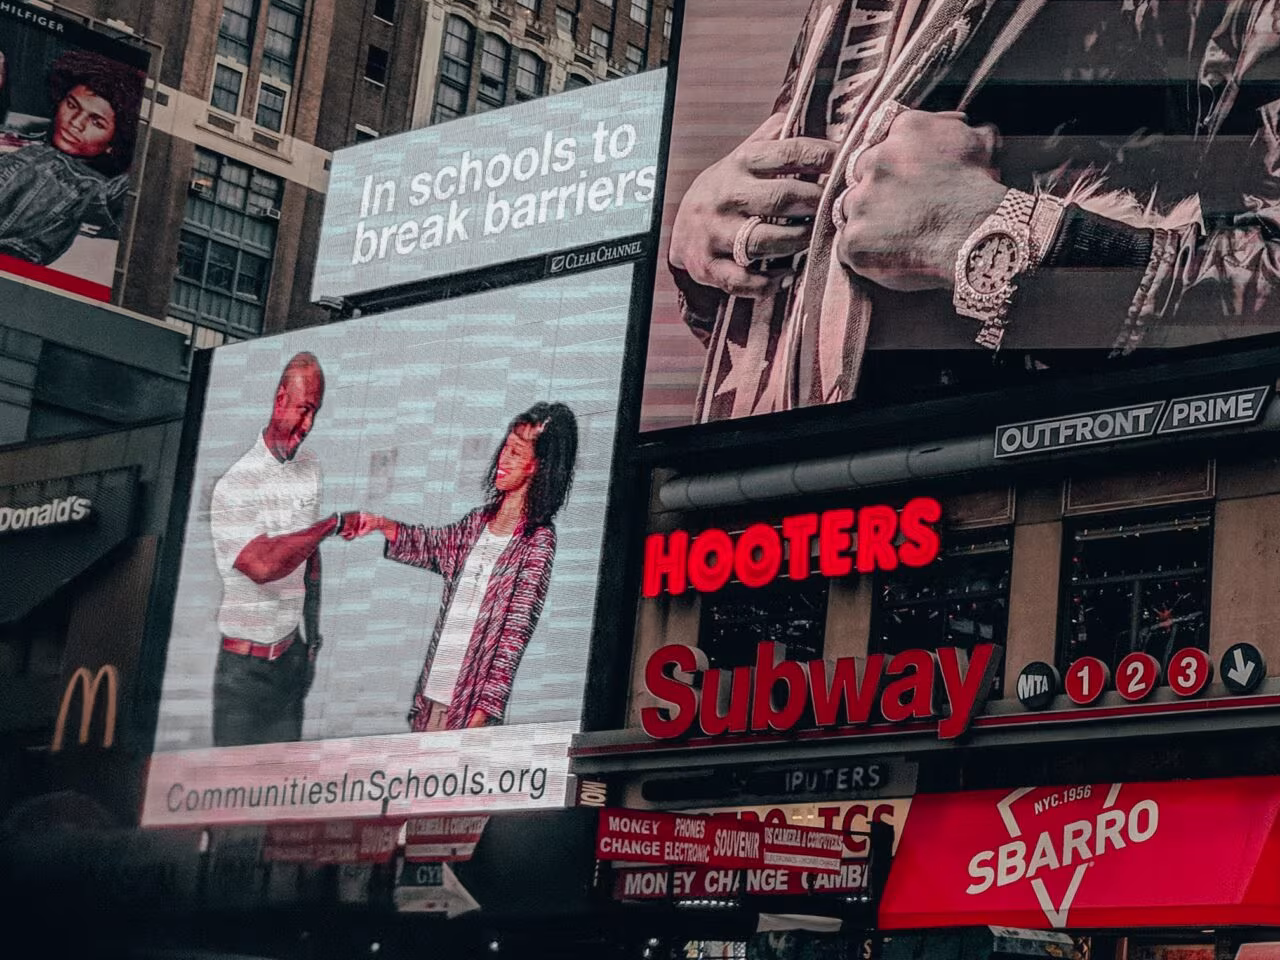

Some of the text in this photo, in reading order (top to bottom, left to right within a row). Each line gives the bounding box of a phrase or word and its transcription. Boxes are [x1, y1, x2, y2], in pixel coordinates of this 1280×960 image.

[0, 1, 65, 33] HILFIGER
[359, 120, 637, 218] In schools to
[351, 165, 657, 265] break barriers
[1001, 393, 1256, 453] OUTFRONT PRIME
[642, 496, 943, 599] HOOTERS
[639, 639, 998, 740] Subway
[1017, 656, 1198, 700] MTA 1 2 3
[166, 765, 549, 813] CommunitiesInSchools.org
[1033, 784, 1092, 816] NYC.1956
[608, 815, 661, 836] MONEY
[674, 817, 706, 840] PHONES
[713, 828, 760, 860] SOUVENIR
[599, 836, 661, 857] CHANGE
[663, 840, 711, 864] ELECTRONIC
[965, 798, 1160, 896] SBARRO
[624, 870, 697, 896] MONEY
